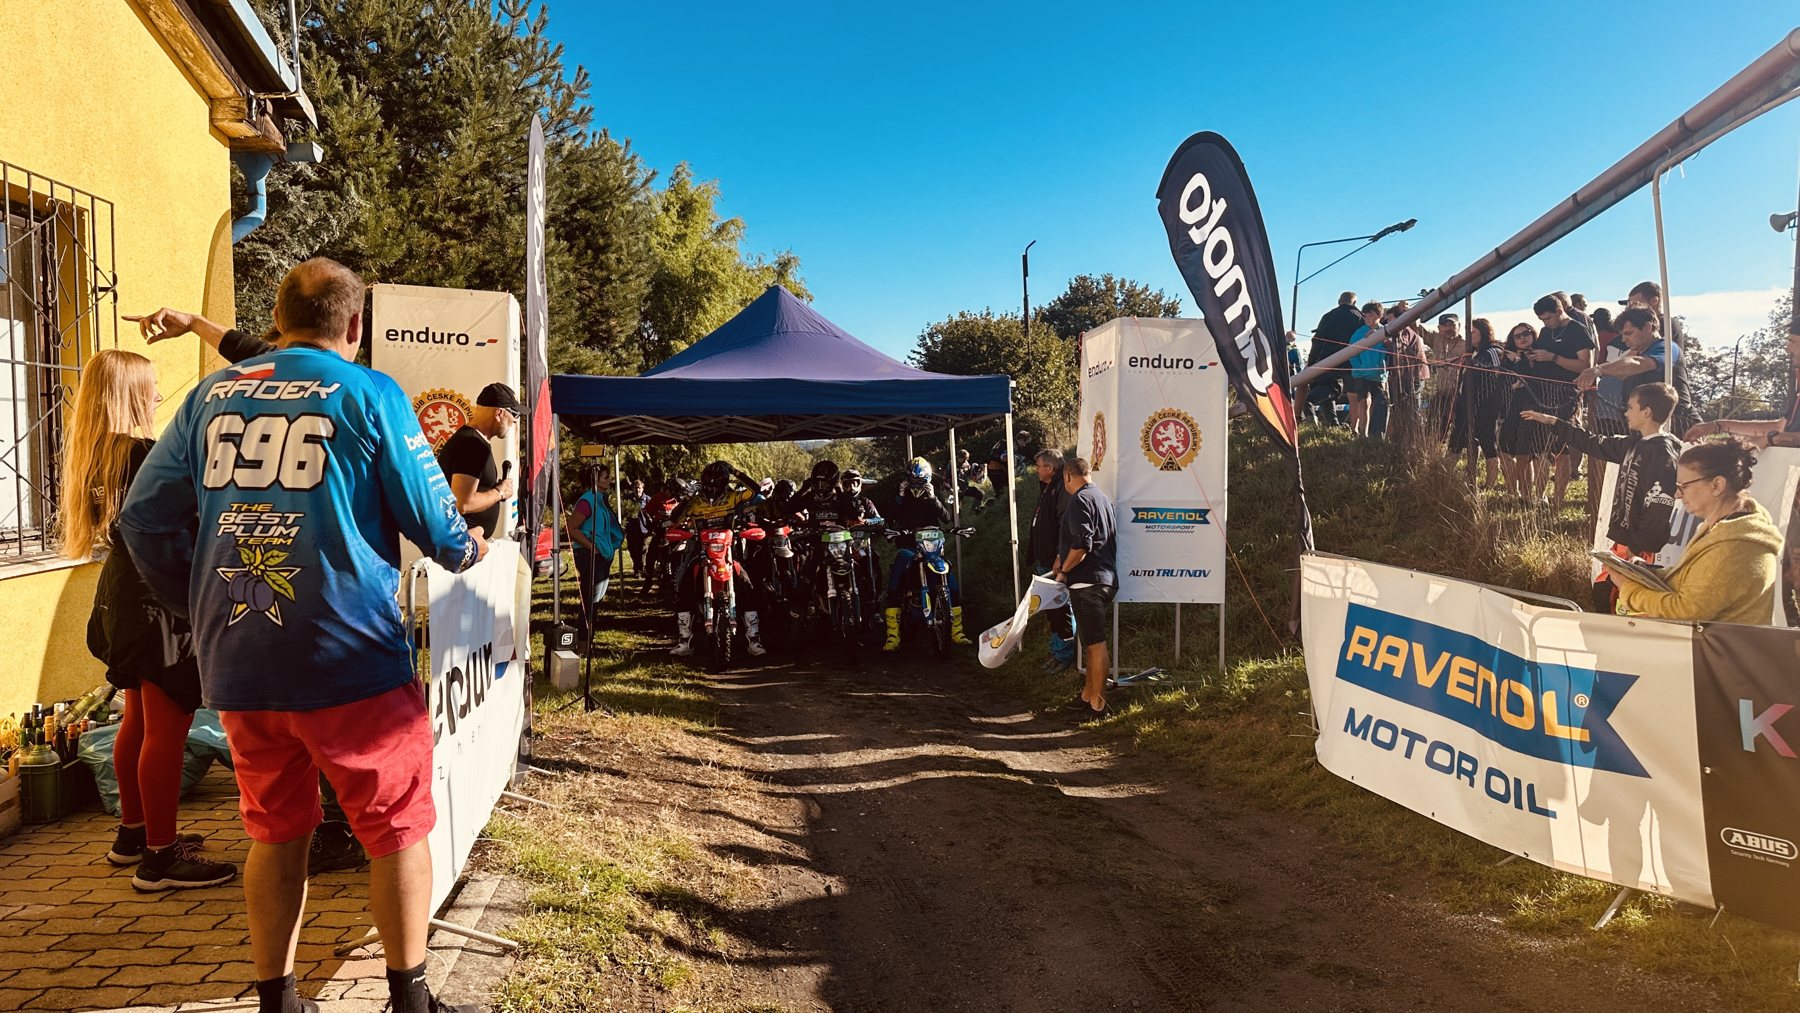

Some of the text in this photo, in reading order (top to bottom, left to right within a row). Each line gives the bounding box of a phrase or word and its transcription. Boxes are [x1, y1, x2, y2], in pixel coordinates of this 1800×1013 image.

[385, 326, 469, 345] enduro
[1128, 353, 1194, 370] enduro
[205, 379, 342, 404] RADEK
[1144, 417, 1158, 452] AUTOKLUB
[1181, 416, 1198, 452] REPUBLIKY
[202, 411, 337, 490] 696
[230, 503, 274, 512] THE
[1138, 511, 1204, 521] RAVENOL
[217, 512, 305, 525] BEST
[217, 524, 301, 538] PLUM
[236, 537, 294, 546] TEAM
[1129, 568, 1211, 578] AUTO TRUTNOV
[1343, 707, 1557, 819] MOTOR OIL
[1730, 832, 1789, 855] ABUS
